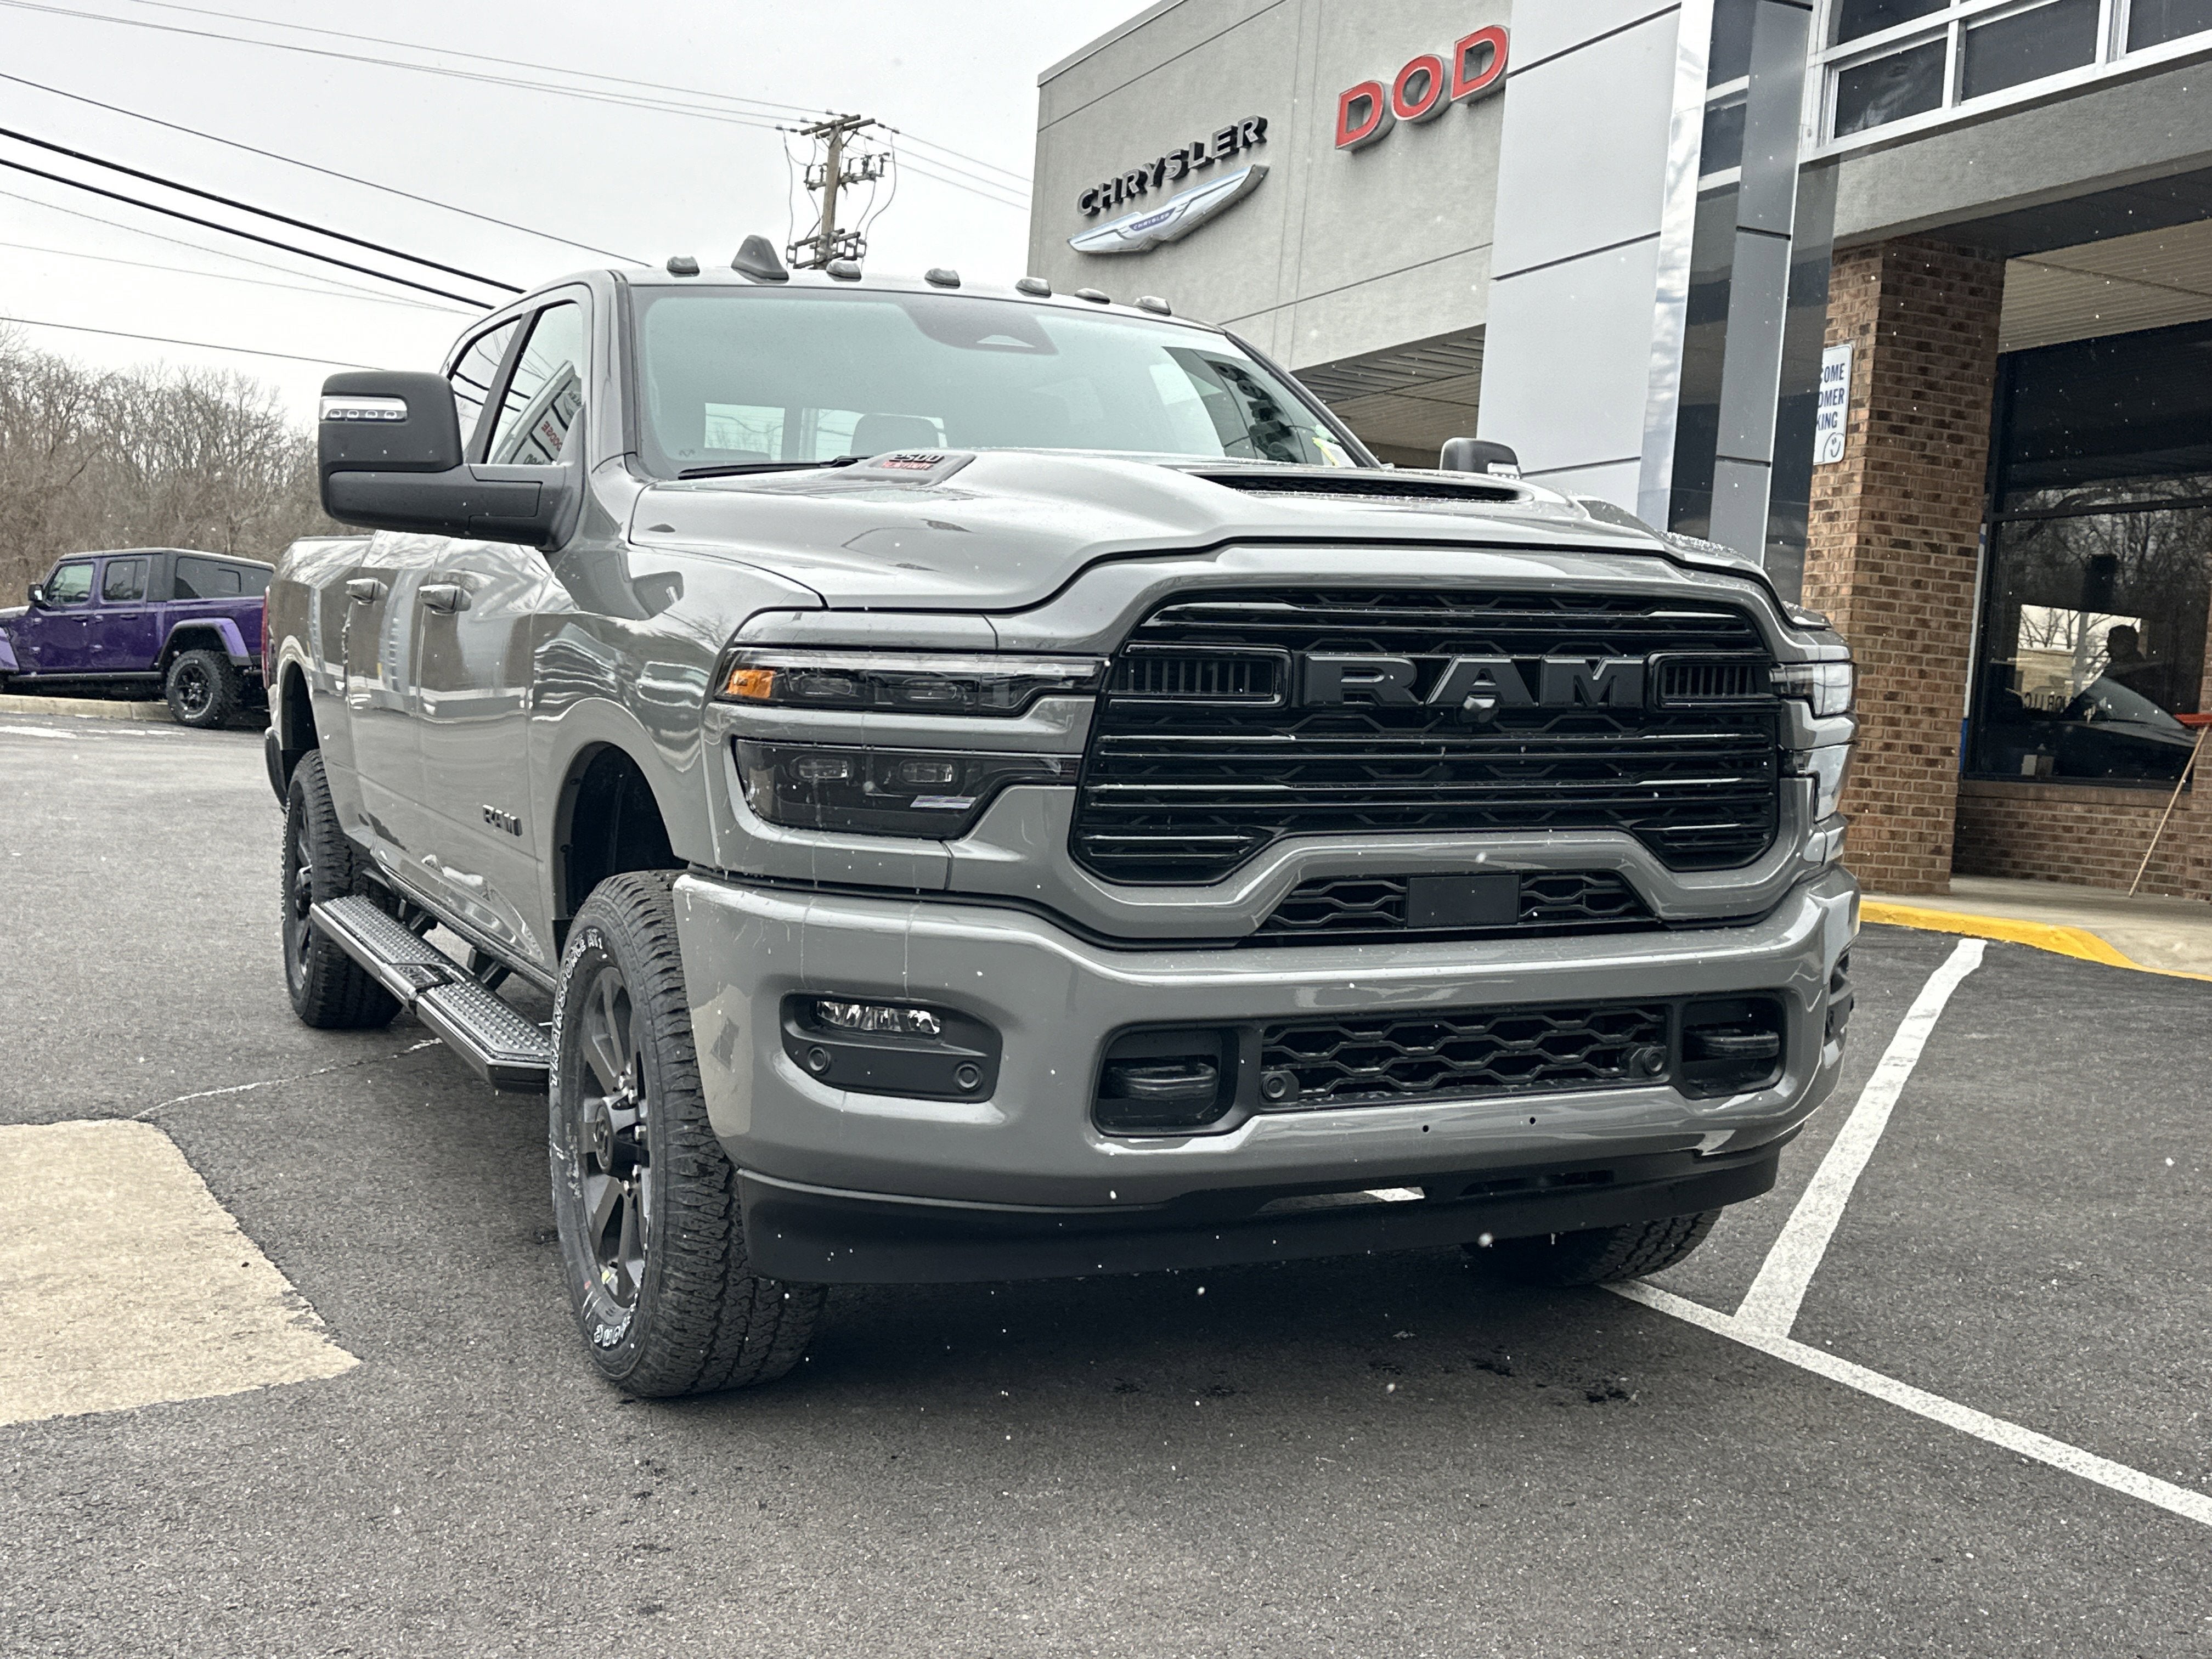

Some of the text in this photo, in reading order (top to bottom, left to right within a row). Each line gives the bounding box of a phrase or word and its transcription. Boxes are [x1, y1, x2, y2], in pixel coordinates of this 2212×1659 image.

[1077, 115, 1268, 216] CHRYSLER
[1821, 363, 1845, 383] OME
[889, 453, 945, 464] 2500
[1304, 655, 1645, 707] RAM
[482, 804, 523, 837] RAM
